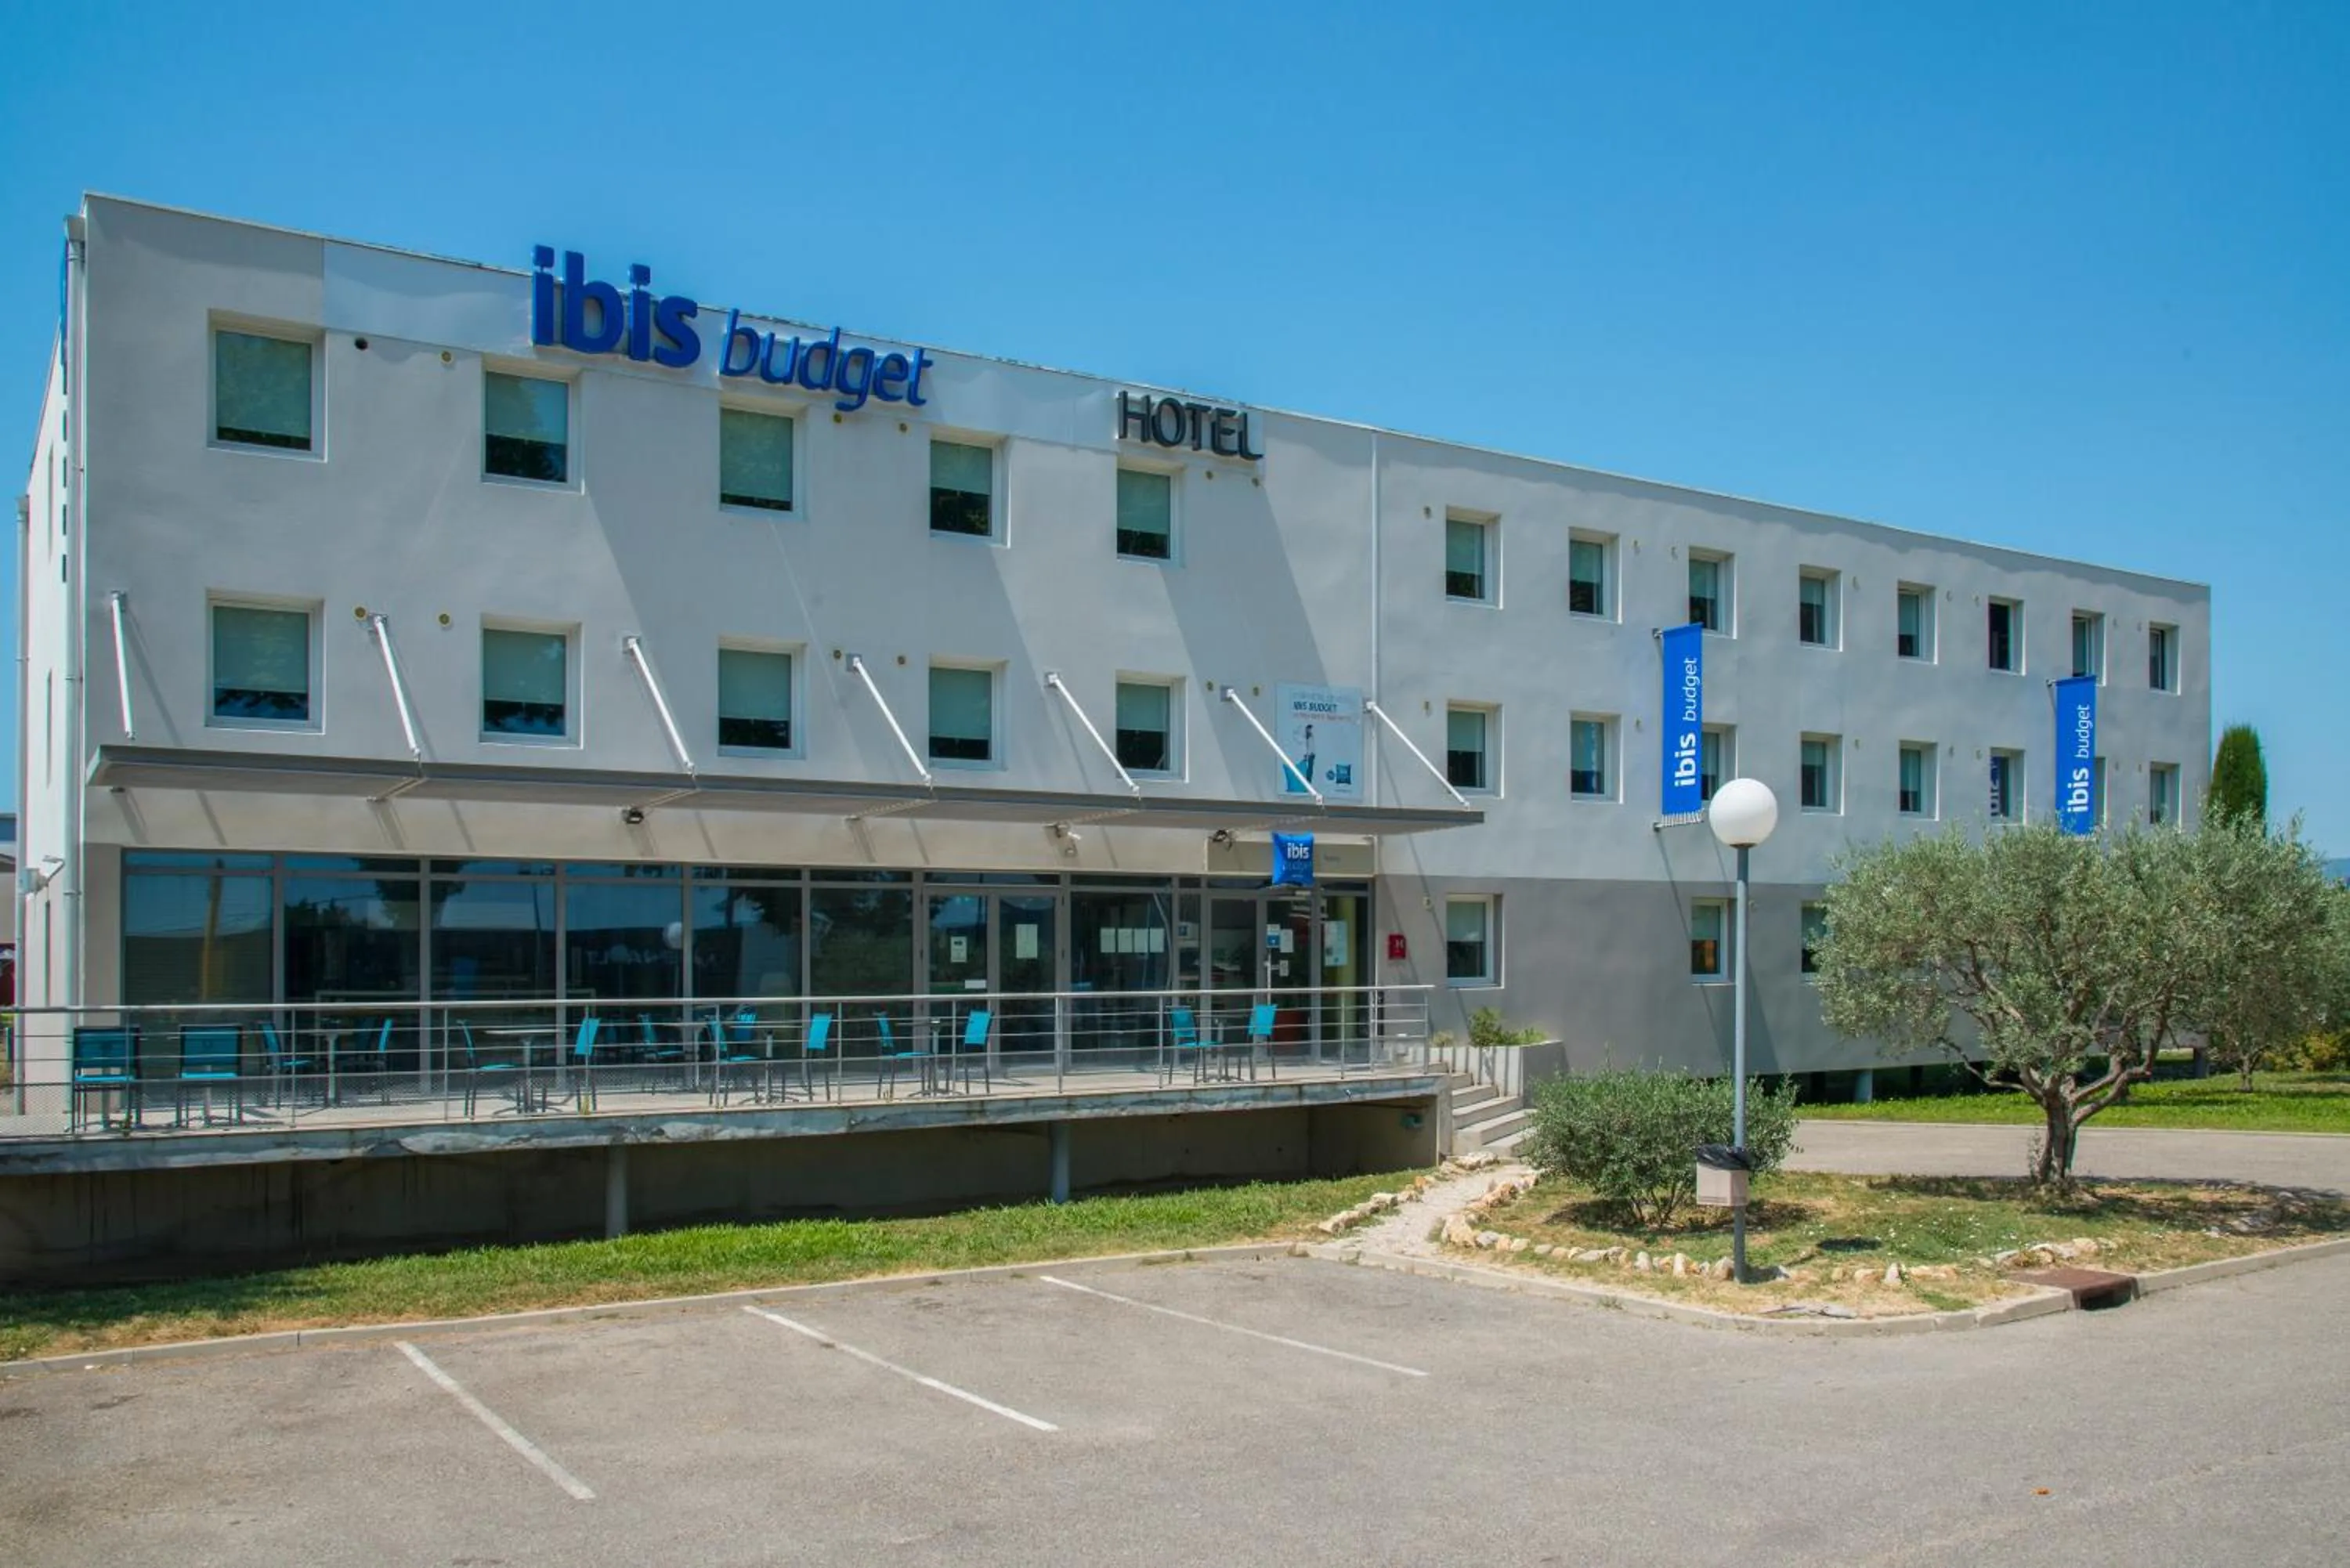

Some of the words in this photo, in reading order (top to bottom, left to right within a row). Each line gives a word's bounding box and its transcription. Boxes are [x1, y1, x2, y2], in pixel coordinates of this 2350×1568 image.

[531, 244, 700, 367] ibis
[719, 309, 933, 411] budget
[1117, 390, 1264, 461] HOTEL
[1682, 657, 1701, 721] budget
[2074, 704, 2094, 759] budget
[1674, 732, 1697, 787] ibis
[2067, 767, 2090, 813] ibis
[1287, 842, 1310, 859] ibis
